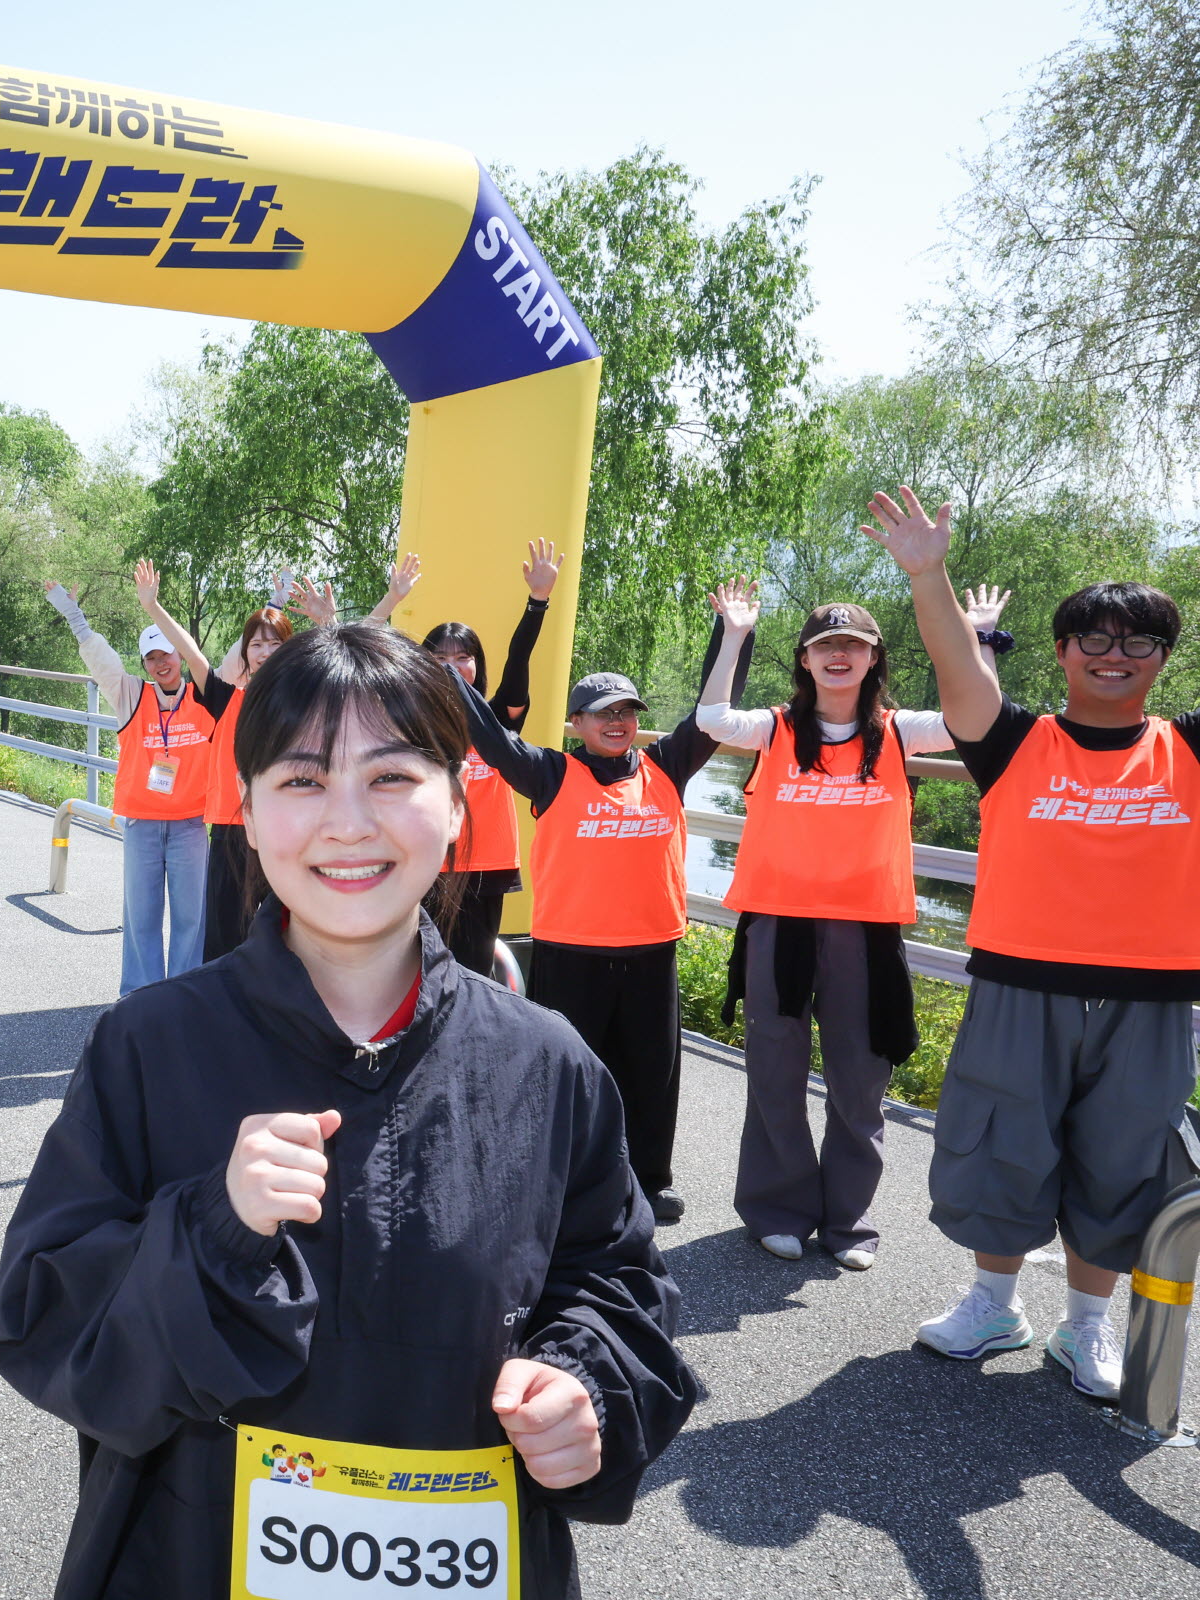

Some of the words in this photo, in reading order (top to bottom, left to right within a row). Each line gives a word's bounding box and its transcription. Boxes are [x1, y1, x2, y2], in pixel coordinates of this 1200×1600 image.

[474, 216, 580, 361] START
[776, 783, 894, 806] 레고랜드런
[1092, 785, 1174, 801] 함께하는
[622, 804, 665, 817] 함께하는
[1027, 796, 1191, 826] 레고랜드런
[576, 816, 675, 839] 레고랜드런
[386, 1470, 499, 1493] 레고랜드런
[259, 1515, 499, 1590] S00339
